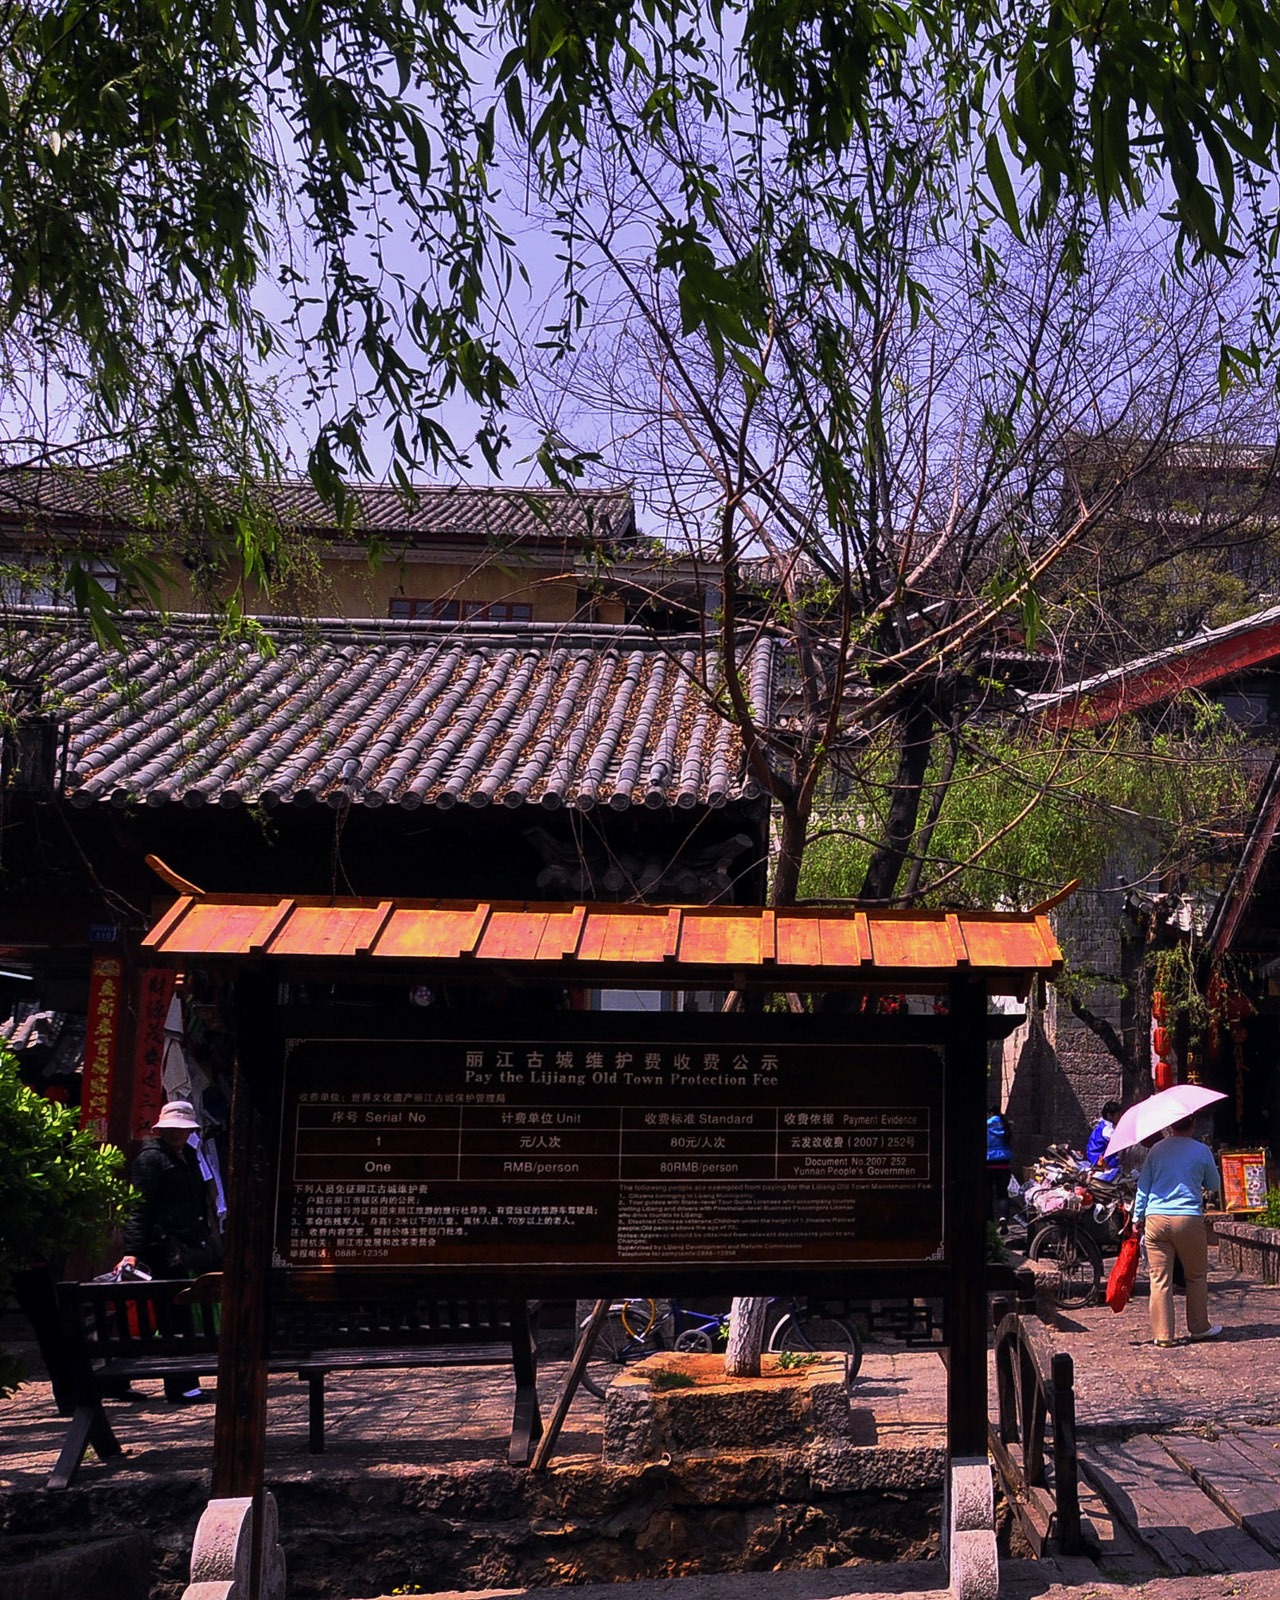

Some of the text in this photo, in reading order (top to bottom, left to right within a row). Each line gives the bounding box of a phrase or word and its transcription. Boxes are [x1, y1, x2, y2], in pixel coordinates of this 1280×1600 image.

[466, 1050, 779, 1071] 丽江古城维护费收费公示
[465, 1071, 778, 1086] Pay the Lijiang Old Town Protection Fee
[331, 1110, 427, 1124] 序号 Serial No
[500, 1111, 582, 1125] 计费单位 Unit
[644, 1112, 754, 1125] 收费标准 Standard
[783, 1112, 918, 1127] 收费依据 Payment Evidence
[375, 1135, 382, 1148] 1
[519, 1135, 562, 1149] 元/人次
[670, 1136, 726, 1149] 80元/人次
[364, 1161, 392, 1173] One
[503, 1161, 580, 1176] RMB/person
[660, 1161, 739, 1175] 80RMB/person
[804, 1157, 848, 1166] Document
[890, 1157, 908, 1166] 252
[793, 1167, 826, 1177] Yunnan
[827, 1167, 864, 1178] People's
